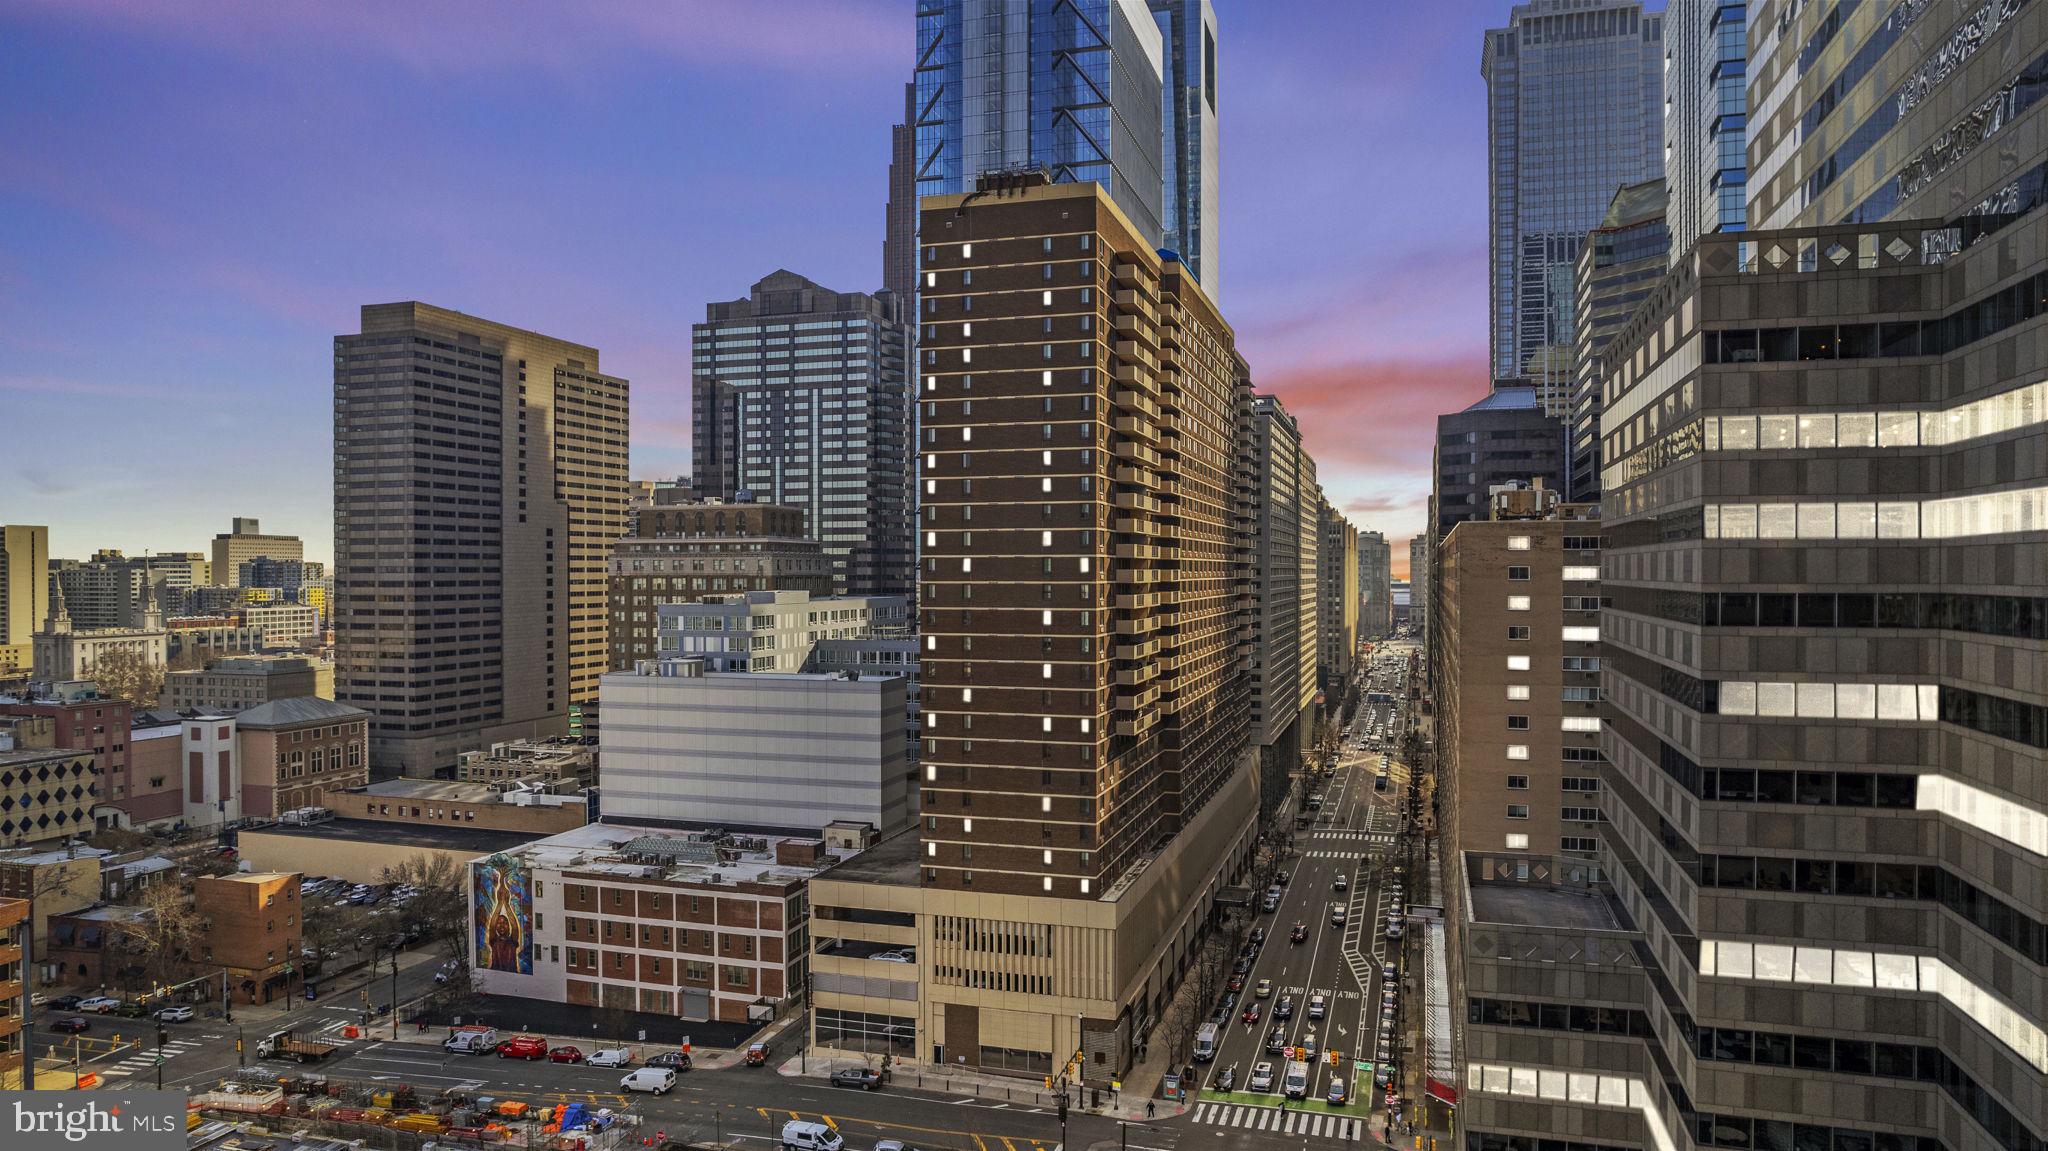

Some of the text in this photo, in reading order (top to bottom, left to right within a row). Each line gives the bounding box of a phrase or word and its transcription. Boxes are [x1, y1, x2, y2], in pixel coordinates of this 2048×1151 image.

[1282, 986, 1304, 995] ONLY
[1309, 988, 1331, 997] ONLY
[1337, 990, 1360, 999] ONLY
